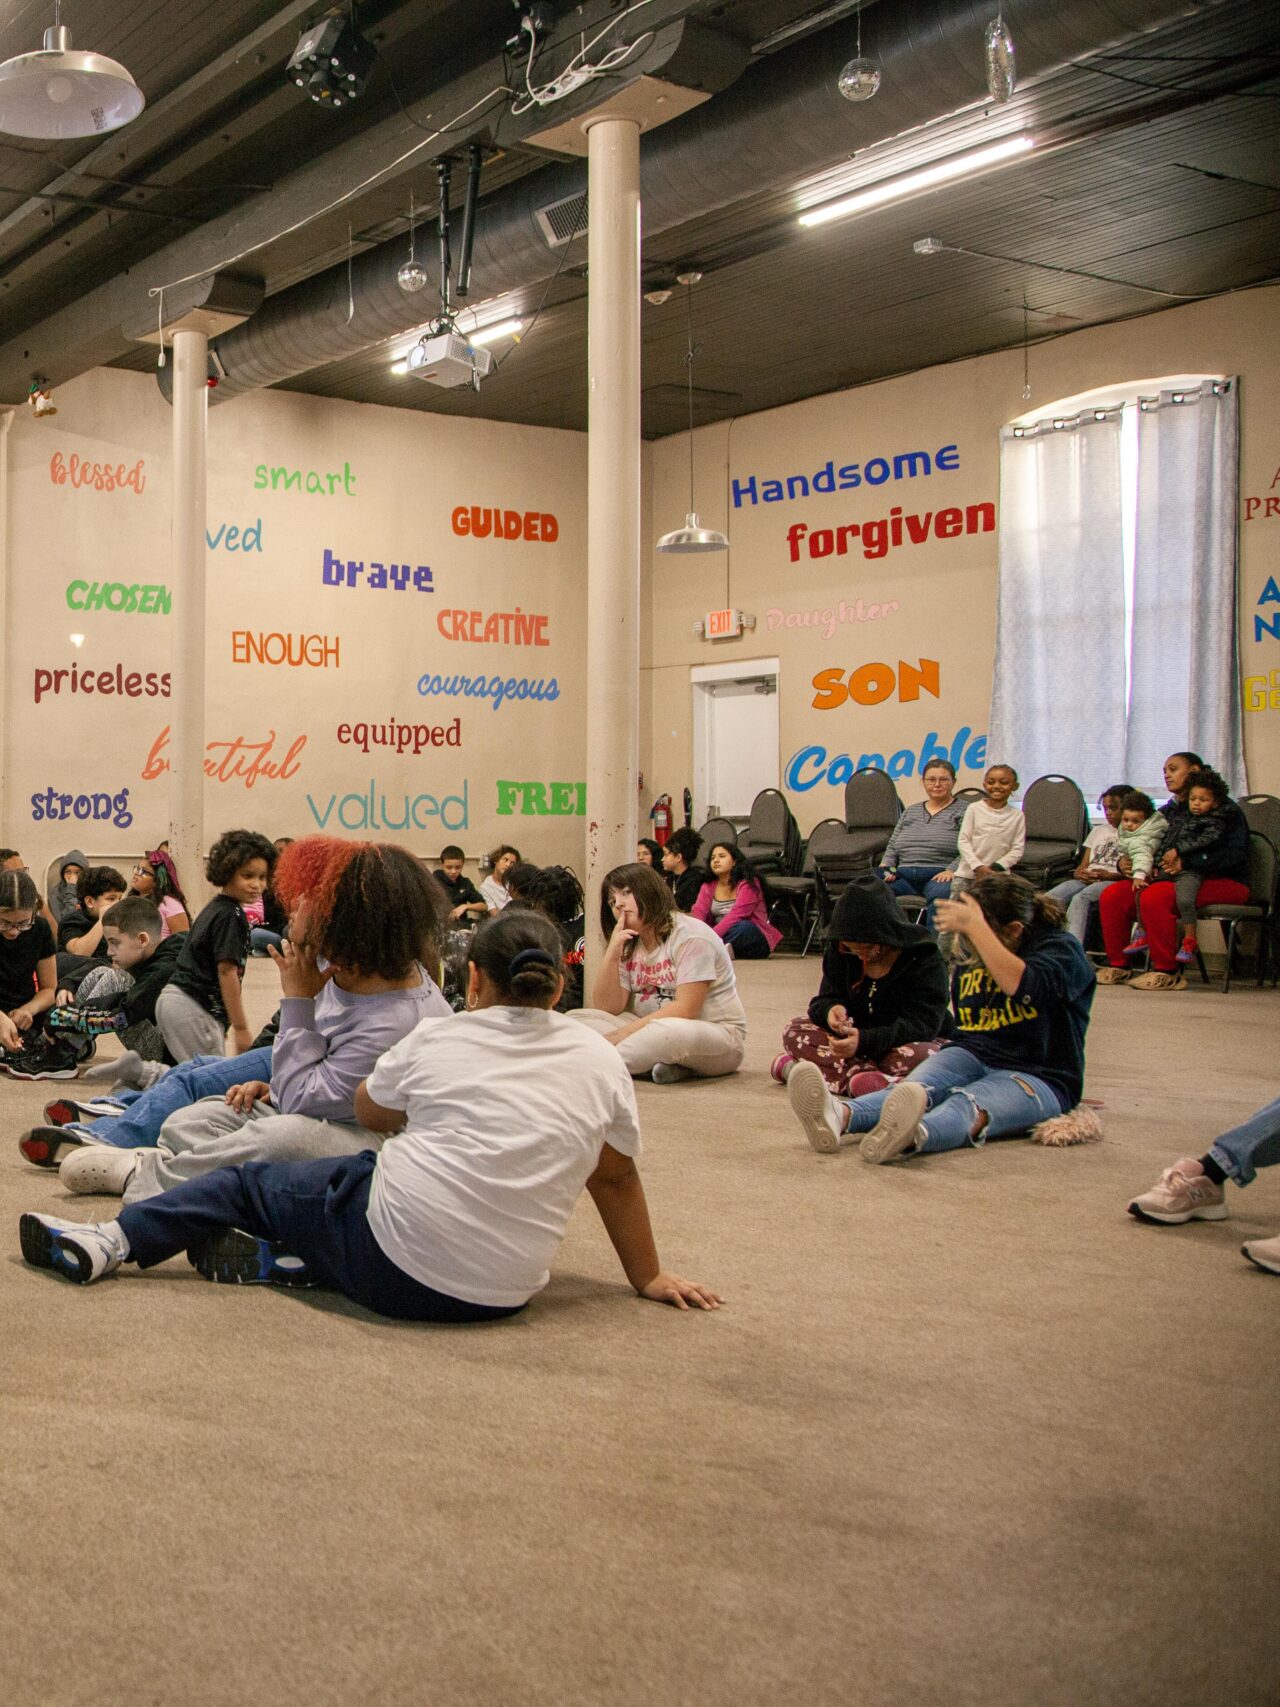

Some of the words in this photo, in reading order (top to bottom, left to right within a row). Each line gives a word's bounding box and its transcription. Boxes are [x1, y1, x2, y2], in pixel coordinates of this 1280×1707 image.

[49, 451, 147, 495] blessed
[253, 461, 357, 497] smart
[731, 444, 961, 509] Handsome
[205, 517, 264, 553] ved
[450, 505, 559, 543] GUIDED
[786, 501, 996, 563] forgiven
[321, 548, 435, 593] brave
[65, 579, 173, 616] CHOSEN
[709, 607, 732, 635] EXIT
[764, 598, 902, 641] Daughter
[231, 630, 340, 669] ENOUGH
[33, 661, 172, 705] priceless
[416, 672, 561, 712] courageous
[811, 657, 940, 711] SON
[141, 724, 308, 789] butiful
[336, 716, 462, 755] equipped
[30, 786, 134, 829] strong
[305, 777, 469, 832] valued
